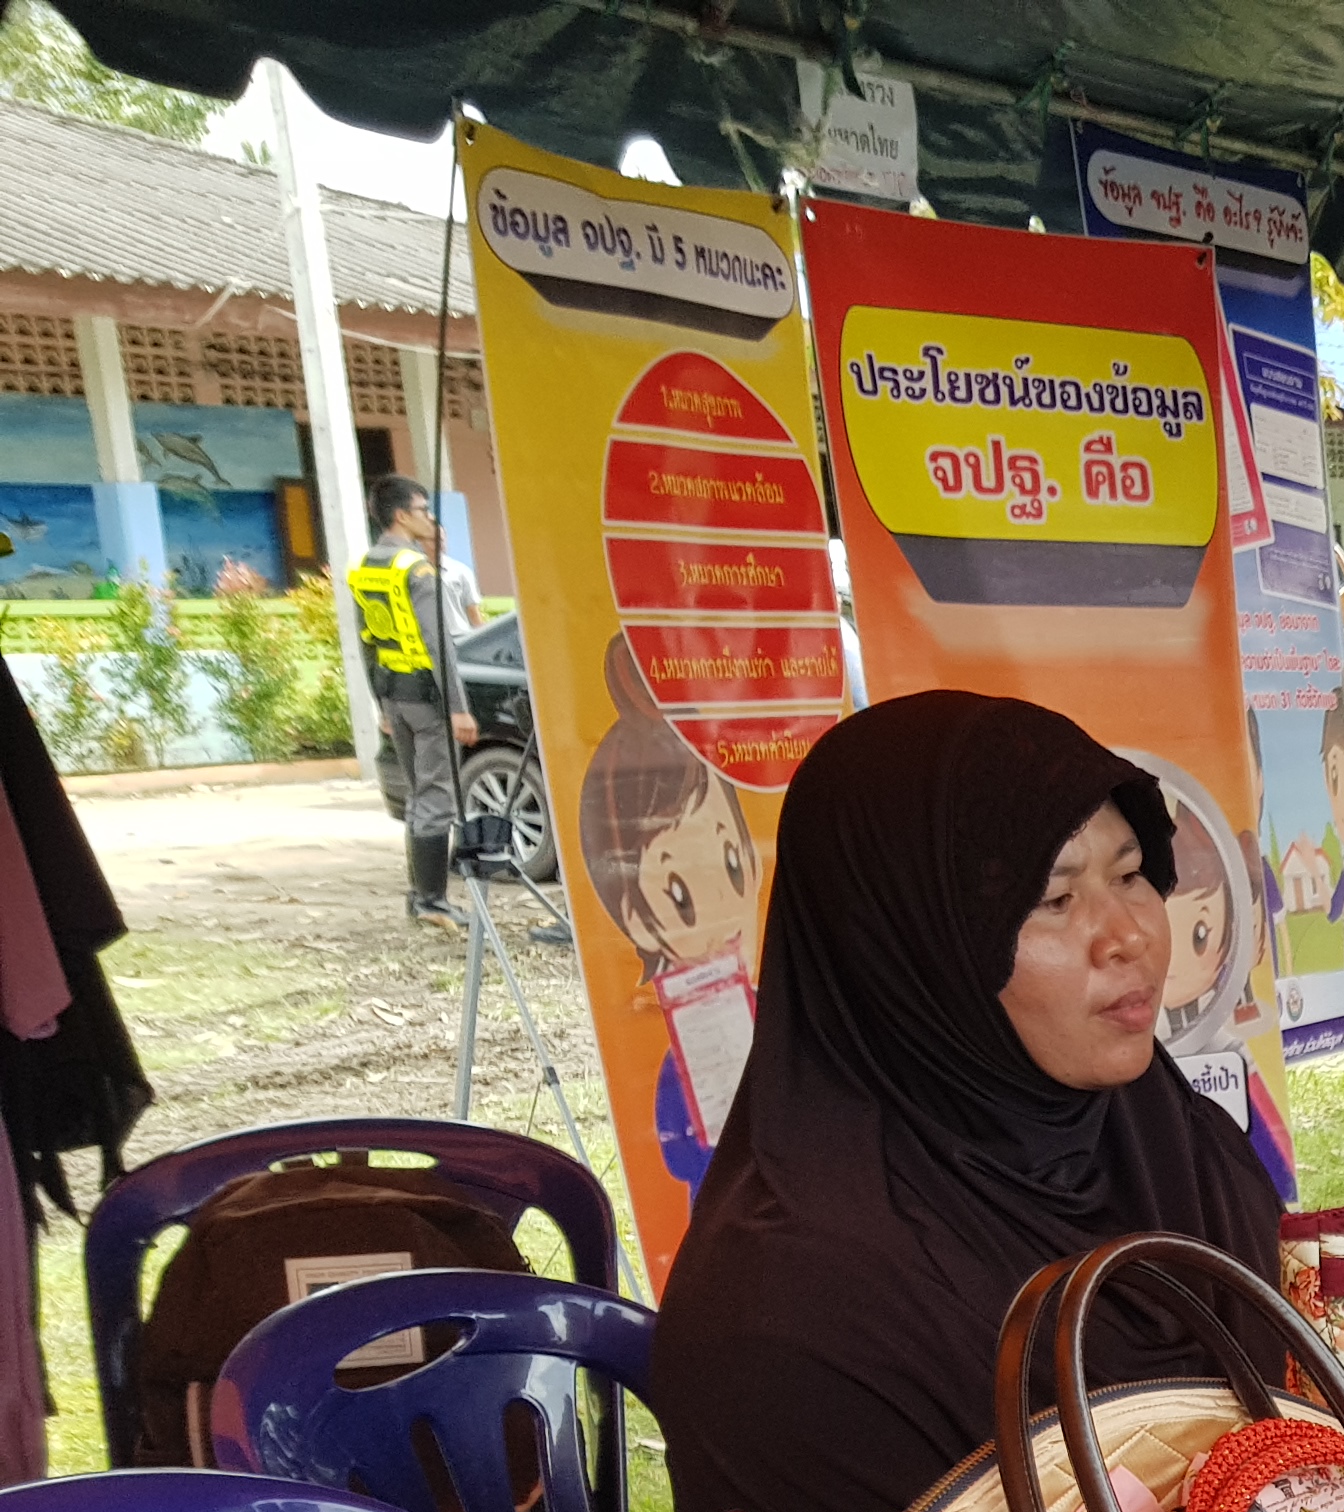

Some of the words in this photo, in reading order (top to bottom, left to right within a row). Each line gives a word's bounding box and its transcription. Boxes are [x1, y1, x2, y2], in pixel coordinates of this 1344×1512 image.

[489, 188, 571, 259] ข้อมูล
[581, 213, 643, 272] จปฐ.
[645, 221, 666, 265] มี
[674, 234, 688, 270] 5
[848, 344, 1205, 439] ประโยชน์ของข้อมูล
[928, 437, 1059, 521] จปฐ.
[1084, 432, 1152, 502] คือ
